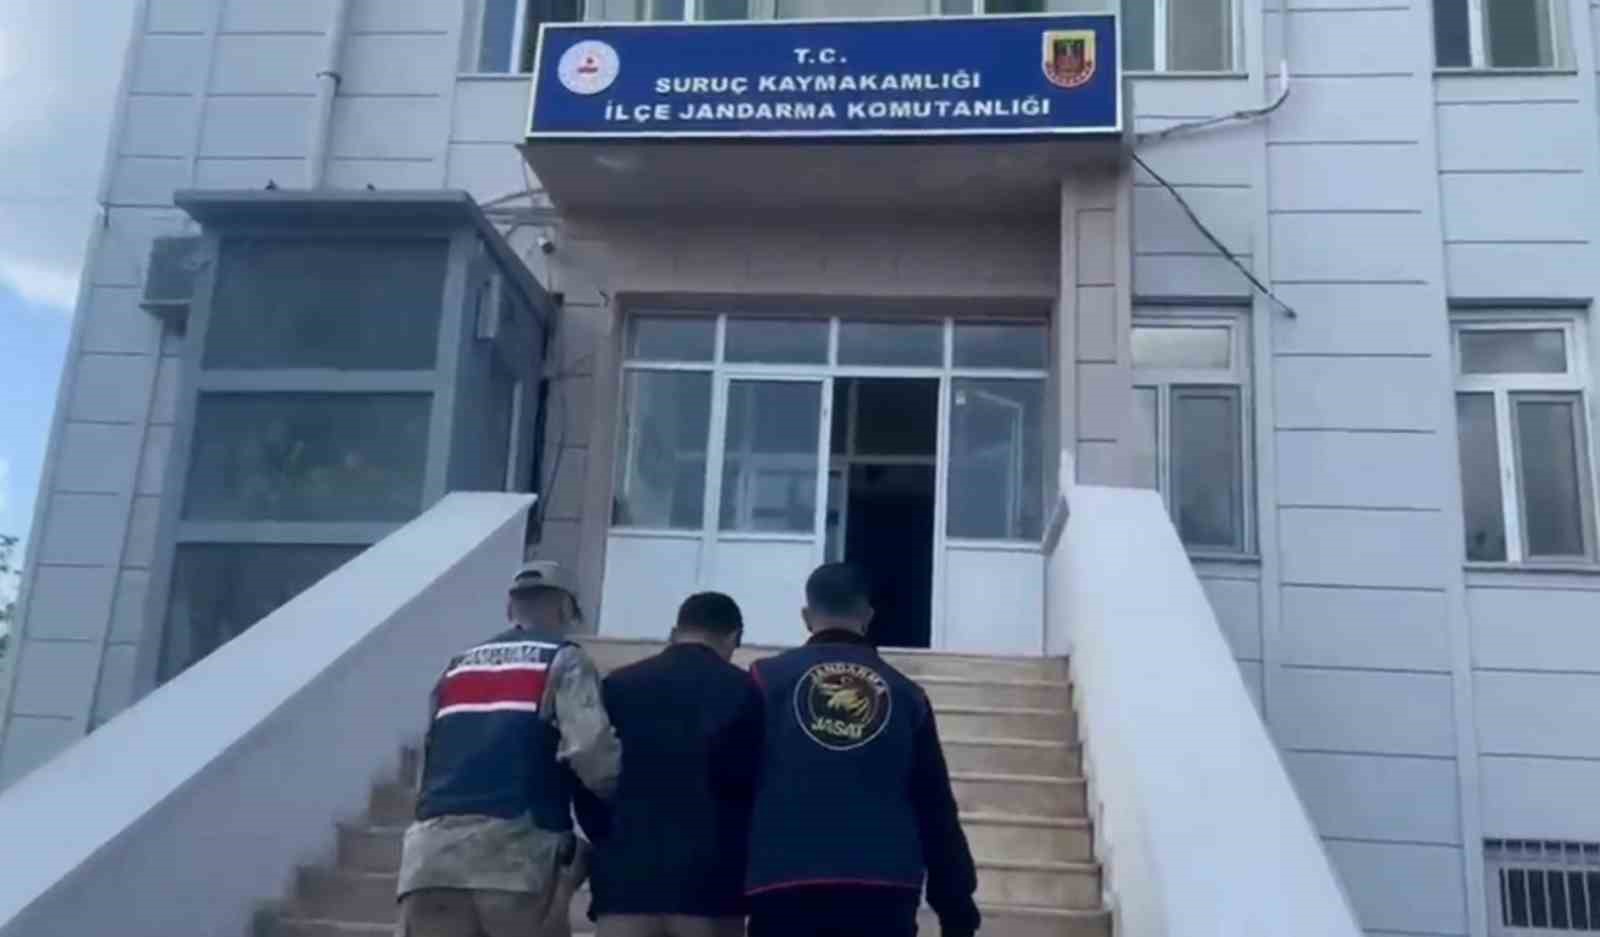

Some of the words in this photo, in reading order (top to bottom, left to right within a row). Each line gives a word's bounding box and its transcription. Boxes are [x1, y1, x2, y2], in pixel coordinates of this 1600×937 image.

[794, 48, 847, 64] T.C.
[655, 76, 748, 94] SURUÇ
[758, 70, 981, 92] KAYMAKAMLIĞI
[605, 99, 671, 122] İLÇE
[679, 102, 836, 120] JANDARMA
[847, 95, 1051, 119] KOMUTANLIĞI
